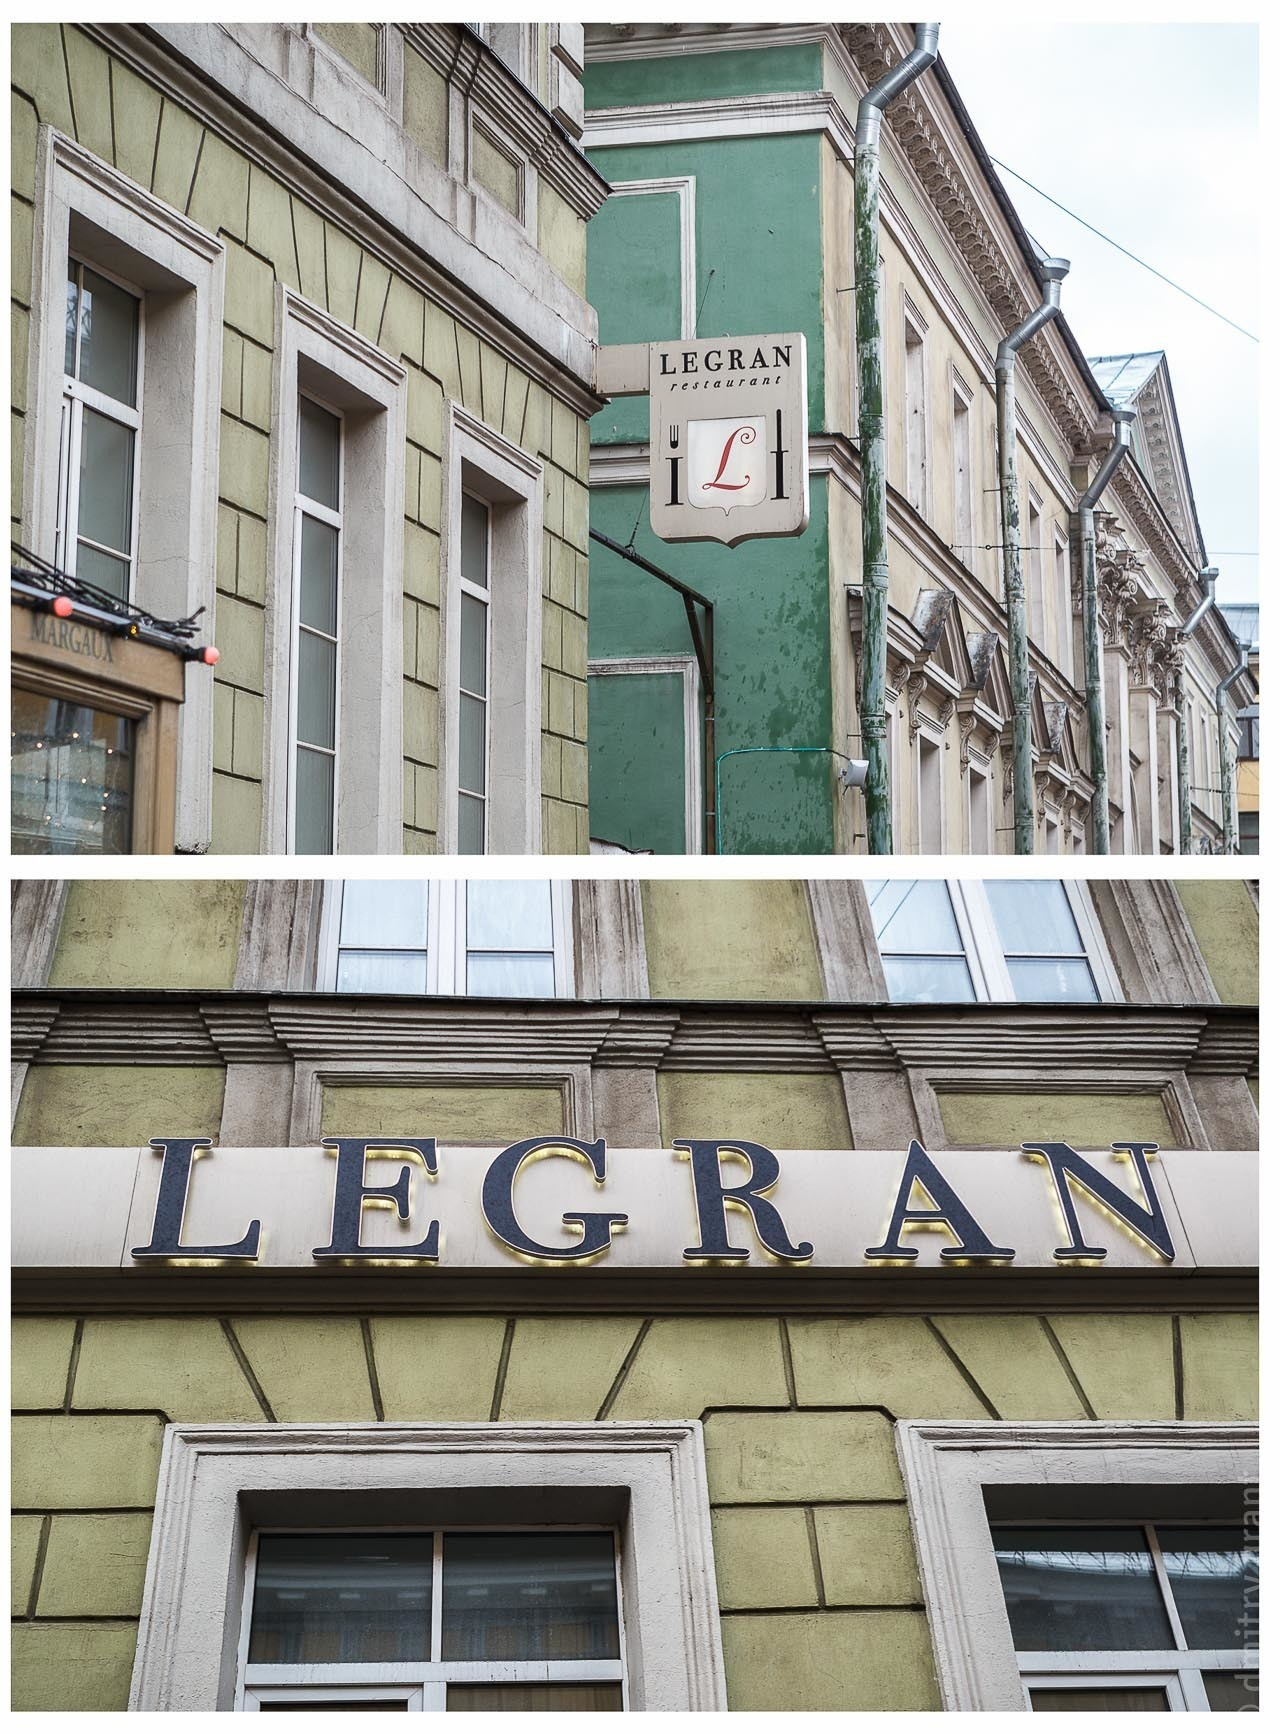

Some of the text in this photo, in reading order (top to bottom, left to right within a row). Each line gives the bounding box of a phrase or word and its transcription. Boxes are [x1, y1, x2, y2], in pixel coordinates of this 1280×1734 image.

[660, 345, 792, 376] LEGRAN
[670, 375, 782, 392] restaurant
[31, 614, 114, 664] MARGAUX
[130, 1136, 1176, 1263] LEGRAN
